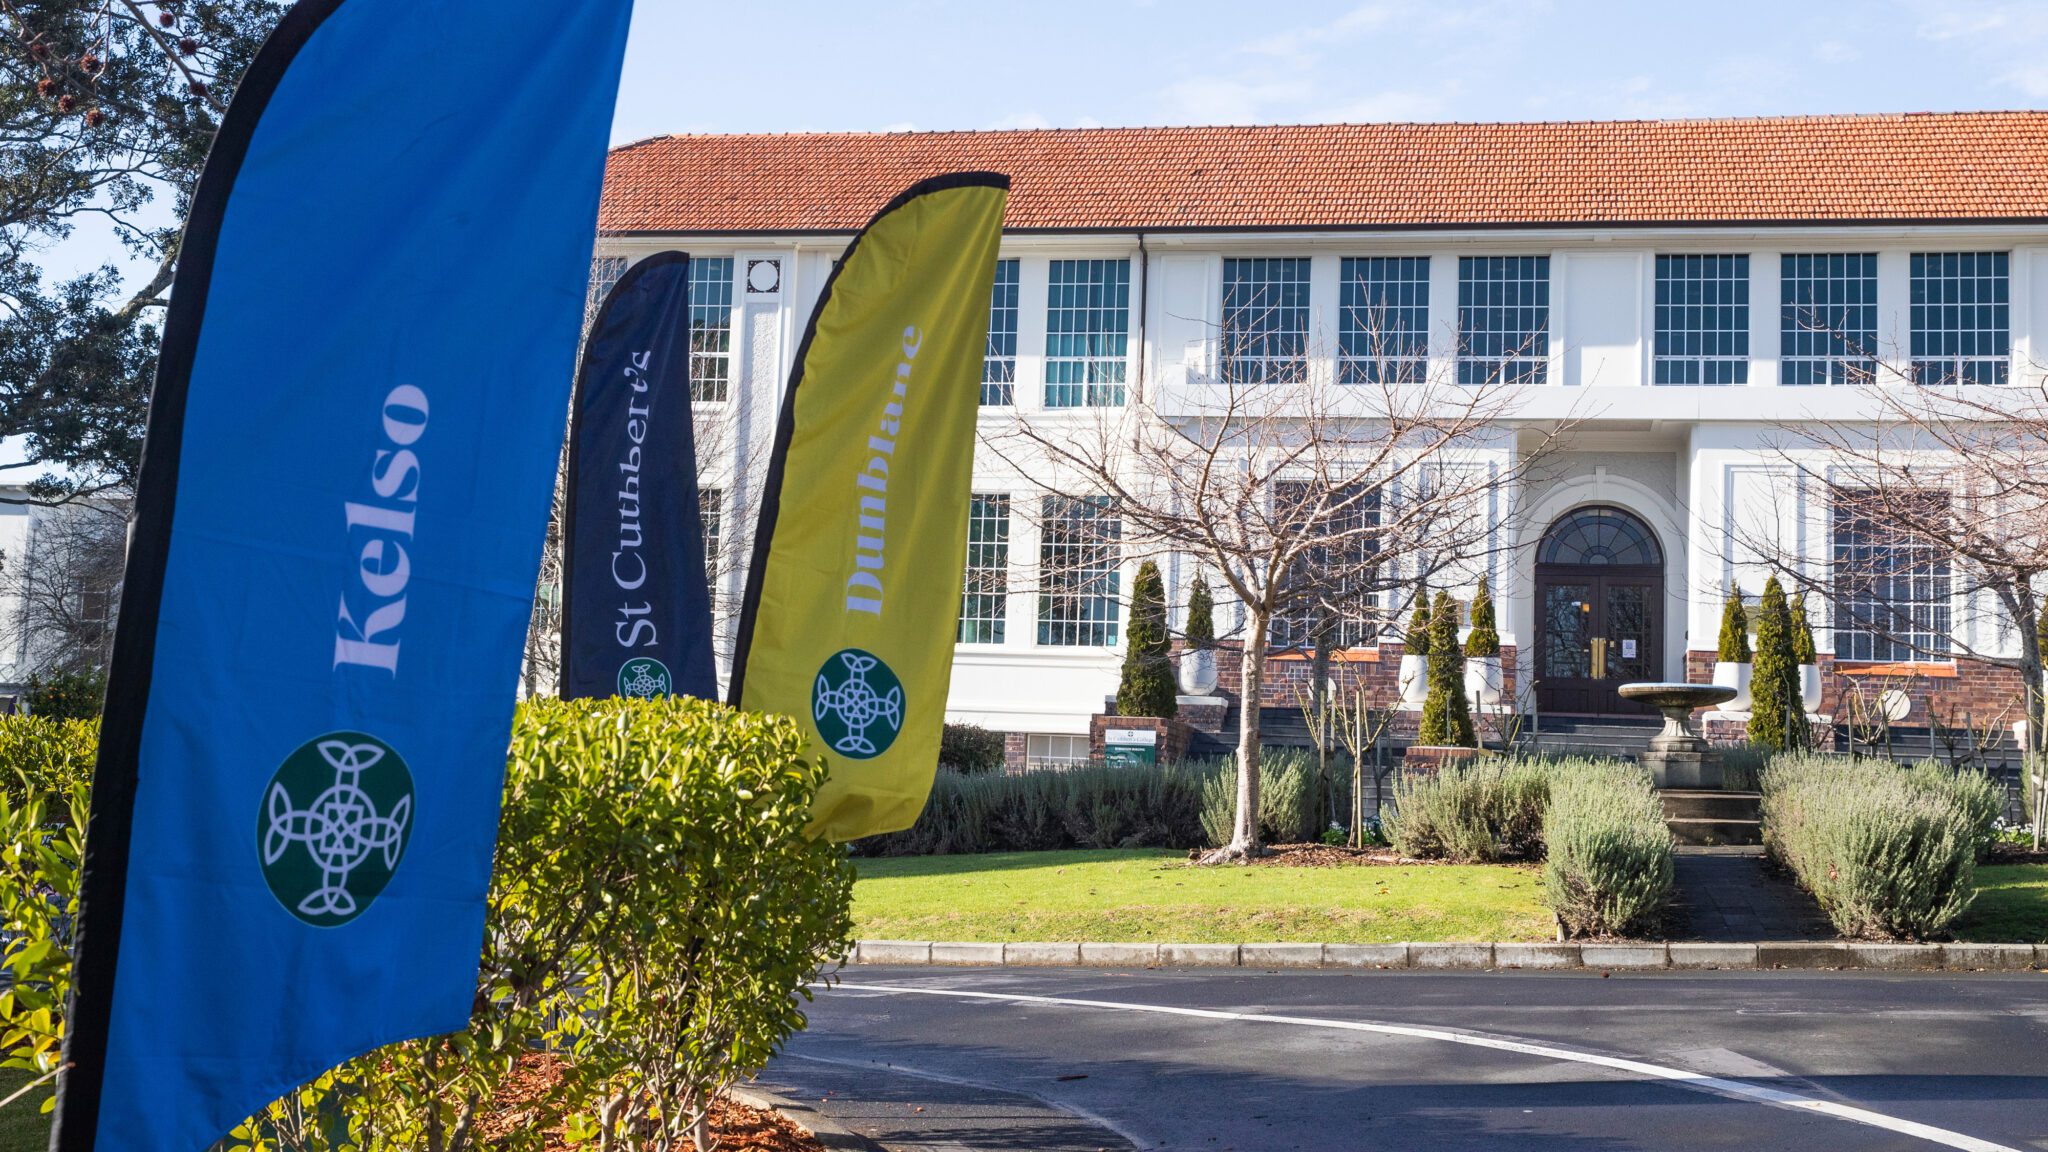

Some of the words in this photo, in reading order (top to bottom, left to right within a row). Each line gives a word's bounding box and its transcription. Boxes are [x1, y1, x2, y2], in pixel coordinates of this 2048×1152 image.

[333, 384, 430, 679] Kelso
[846, 325, 922, 616] Dunblane
[616, 601, 658, 647] St
